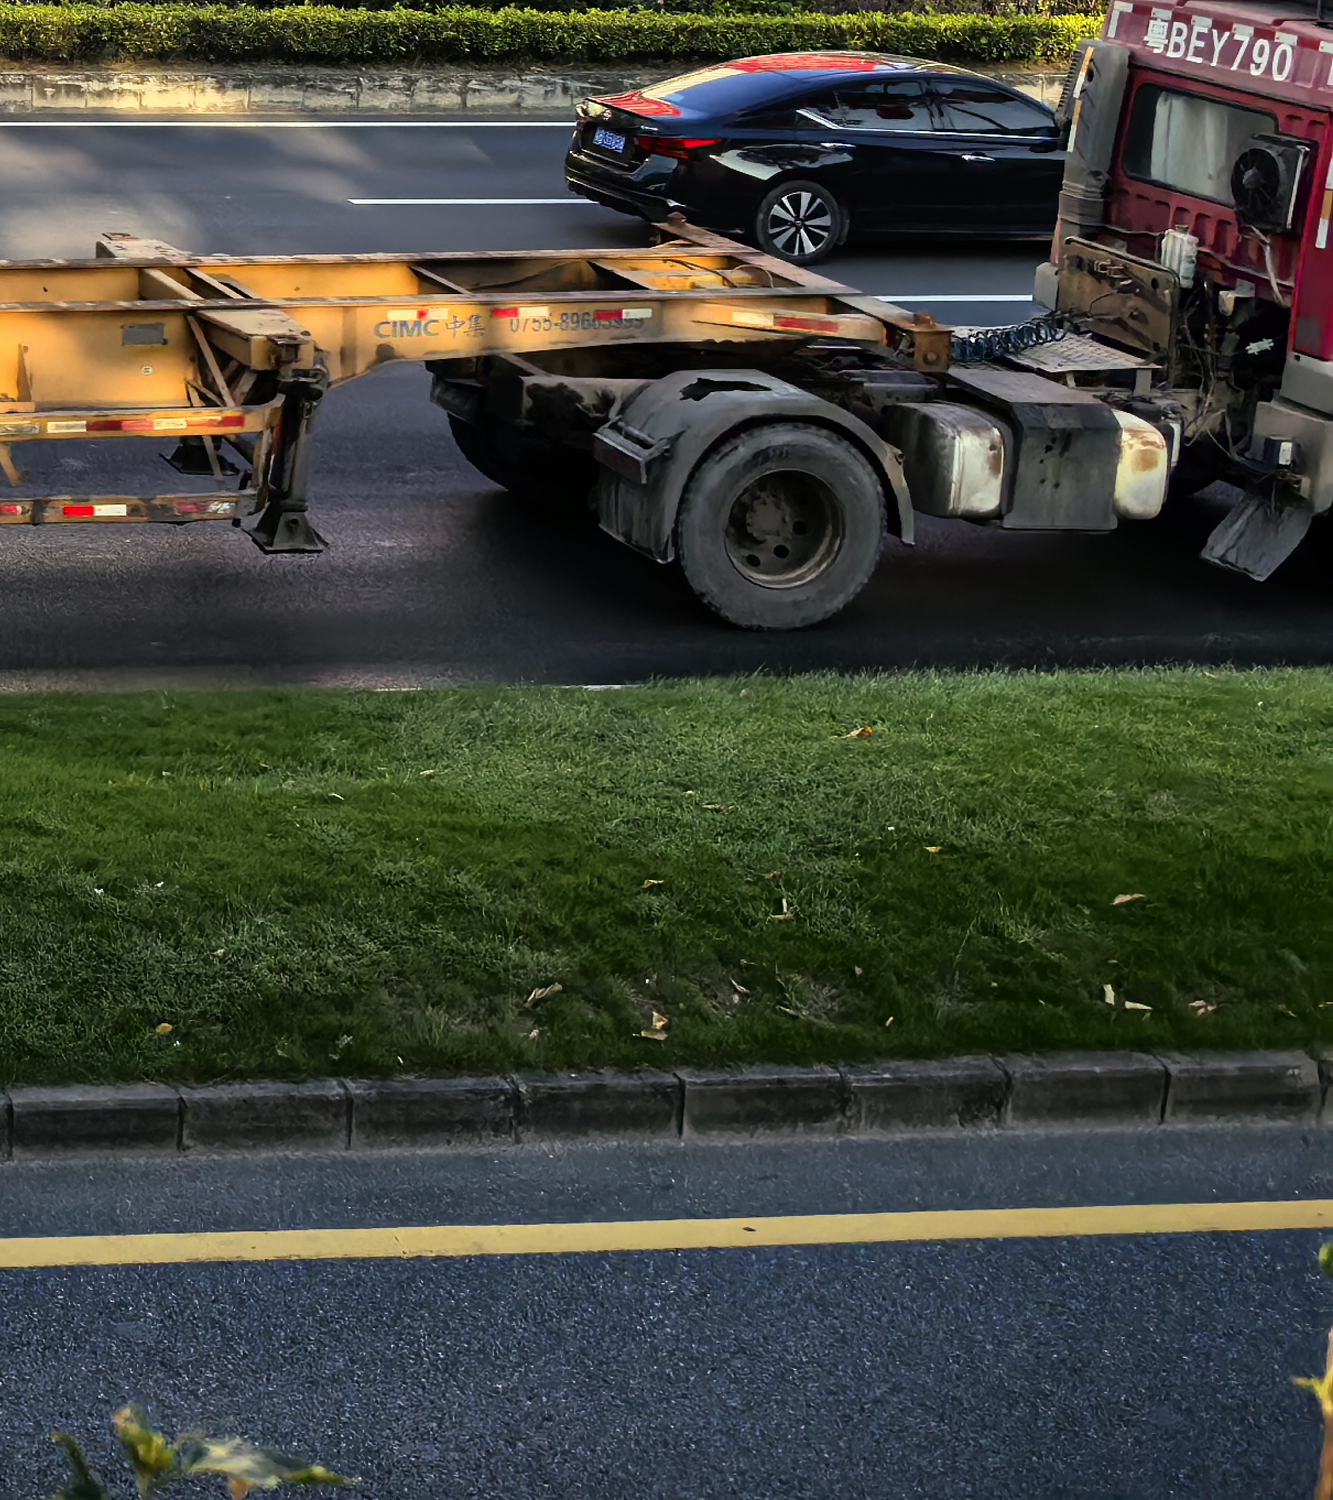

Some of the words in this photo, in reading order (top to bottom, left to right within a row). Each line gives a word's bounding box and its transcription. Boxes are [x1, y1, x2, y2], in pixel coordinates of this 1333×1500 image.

[1143, 18, 1293, 82] 粤BEY790
[374, 319, 441, 339] CIMC
[445, 314, 486, 338] 中集
